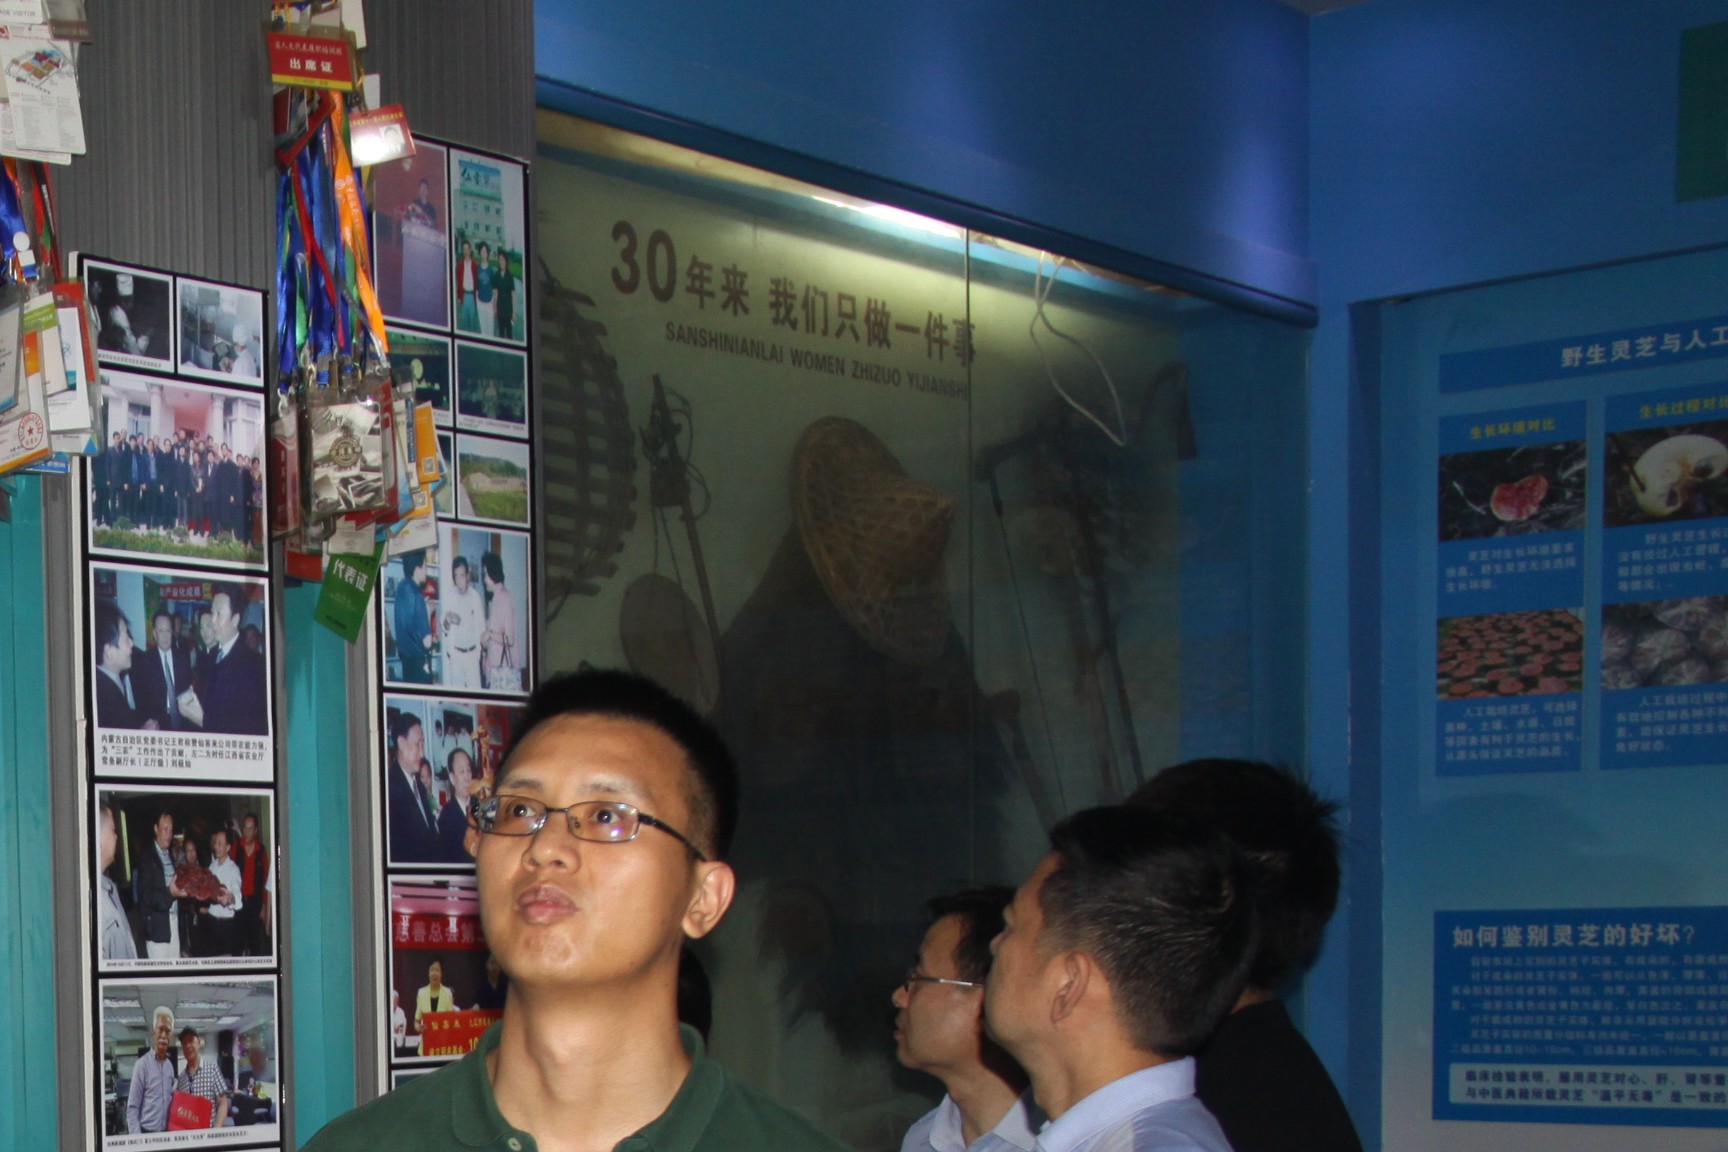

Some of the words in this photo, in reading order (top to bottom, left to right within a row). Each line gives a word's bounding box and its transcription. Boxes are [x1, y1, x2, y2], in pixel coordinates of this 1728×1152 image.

[289, 57, 333, 74] 出席证
[610, 220, 750, 318] 30年来
[768, 277, 976, 367] 我们只做一件事
[665, 322, 784, 364] SANSHINIANLAI
[790, 349, 846, 377] WOMEN
[850, 359, 902, 388] ZHIZUO
[1560, 325, 1728, 368] 野生灵芝与人工
[332, 558, 369, 592] 代表证
